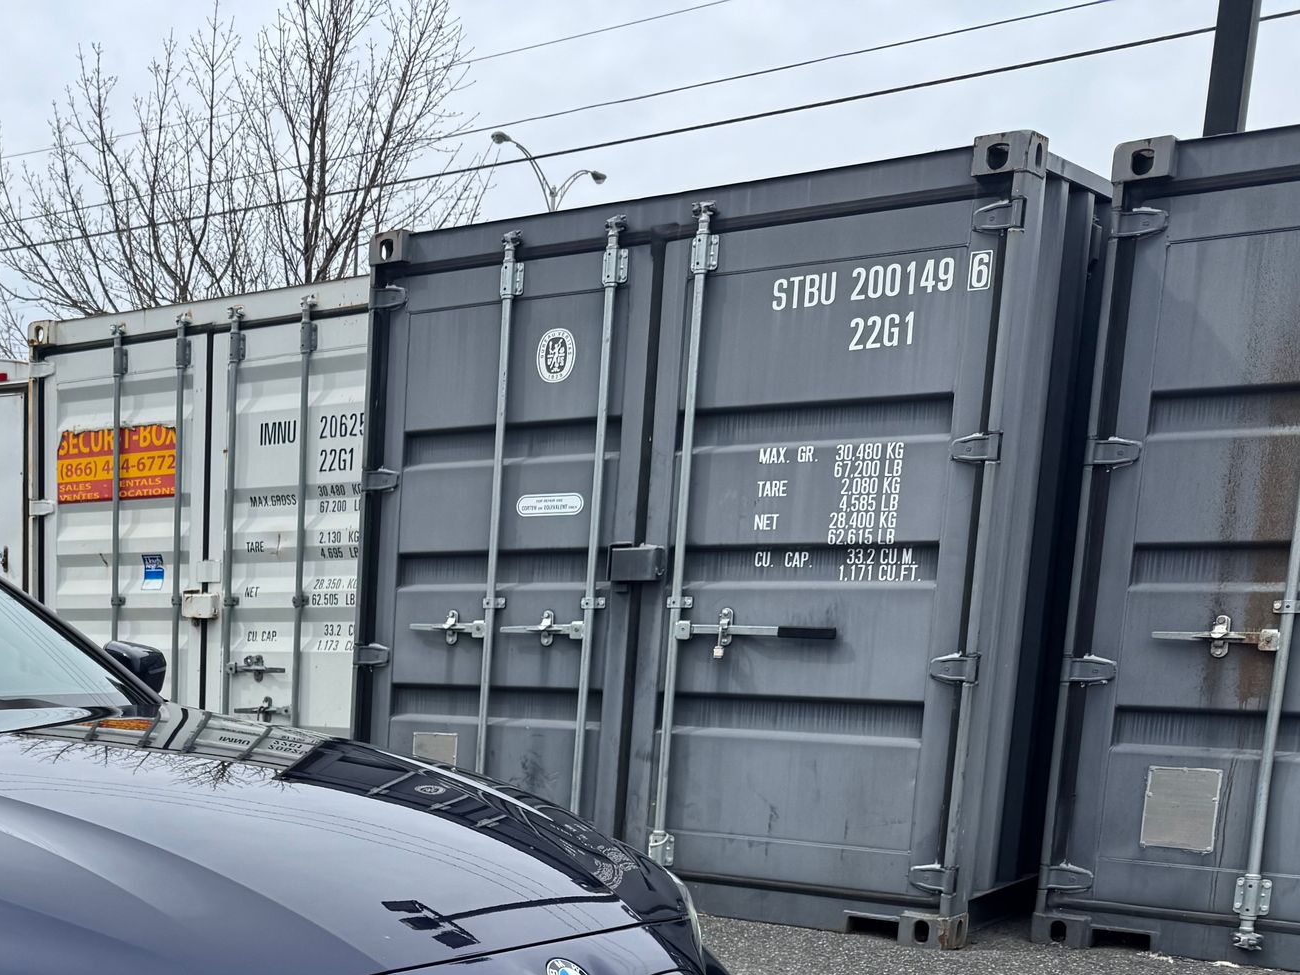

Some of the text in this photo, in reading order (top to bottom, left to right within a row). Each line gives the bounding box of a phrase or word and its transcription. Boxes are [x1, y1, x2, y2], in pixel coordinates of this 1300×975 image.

[771, 252, 990, 312] STBU 200149 6
[848, 311, 915, 351] 22G1
[260, 420, 297, 446] IMNU
[319, 447, 354, 472] 22G1
[759, 442, 904, 464] MAX. GR. 30,480 KG
[60, 454, 176, 480] (866) 44-6772
[834, 459, 903, 478] 67,200 LB
[59, 482, 92, 492] SALES
[119, 478, 162, 488] ENTALS
[59, 492, 100, 501] VENTES
[119, 487, 175, 498] OCATIONS
[757, 477, 901, 497] TARE 2,080 KG
[839, 494, 899, 512] 4,585 LB
[753, 511, 897, 531] NET 28,400 KG
[246, 530, 360, 553] TARE 2.130 KG
[877, 528, 895, 545] LB
[754, 548, 916, 568] CU. CAP. 33.2 CU.M.
[878, 564, 921, 582] CU.FT.
[244, 586, 260, 598] NET
[345, 593, 355, 606] LB
[323, 624, 342, 636] 33.2
